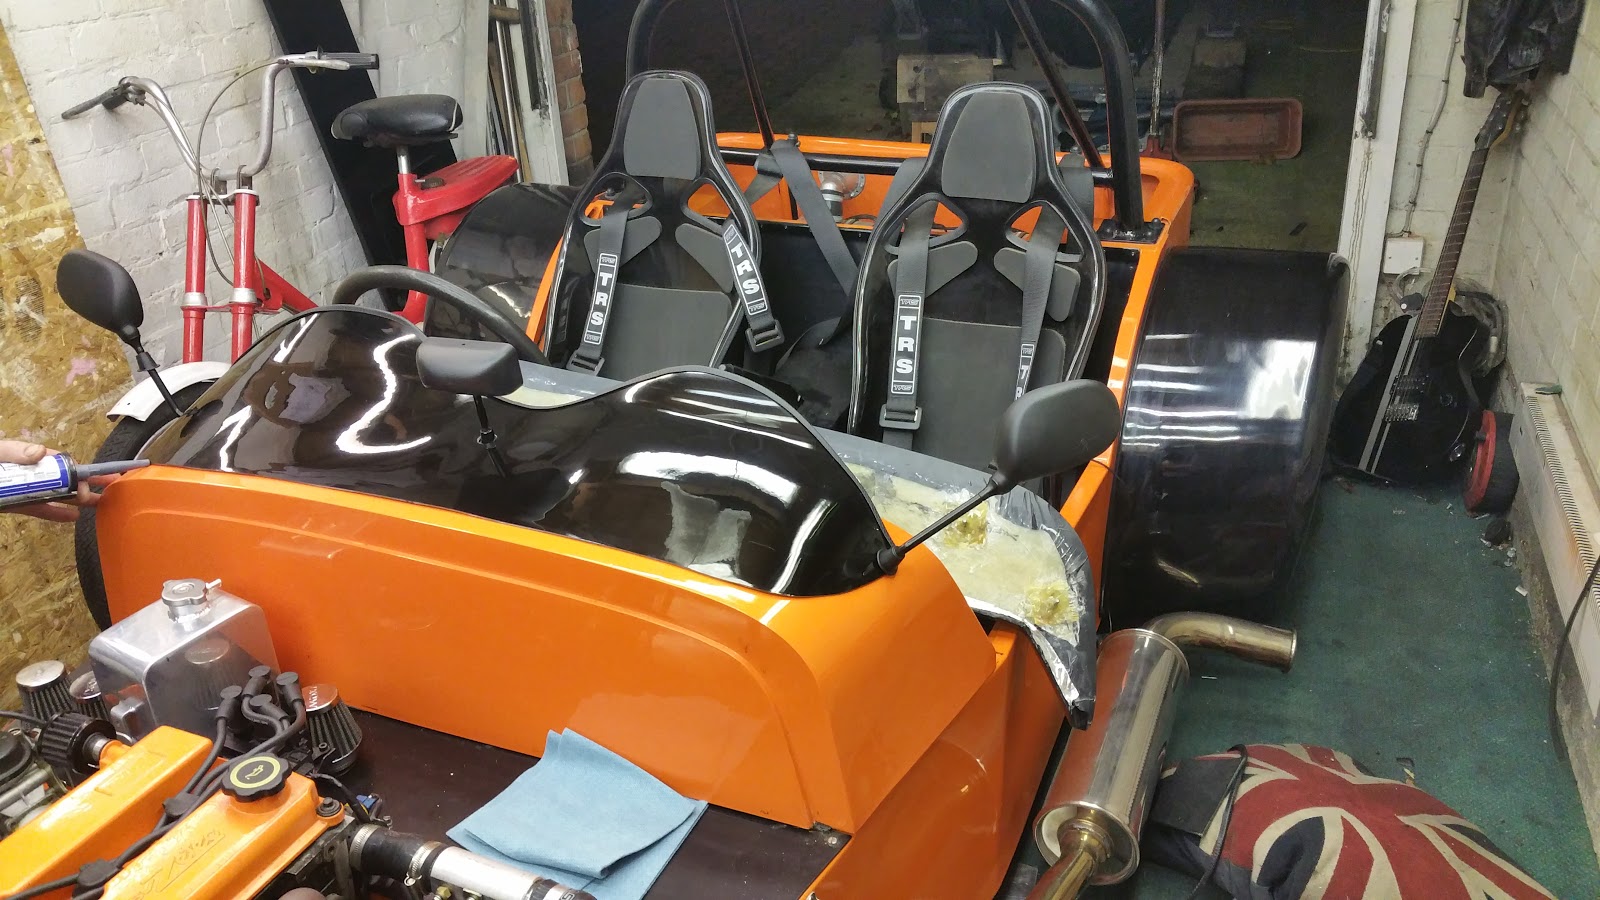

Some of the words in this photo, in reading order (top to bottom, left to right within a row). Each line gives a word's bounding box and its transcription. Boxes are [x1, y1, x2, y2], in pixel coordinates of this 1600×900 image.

[731, 242, 760, 295] TRS
[591, 272, 613, 326] TRS
[896, 315, 917, 374] TRS
[1015, 365, 1030, 400] TR
